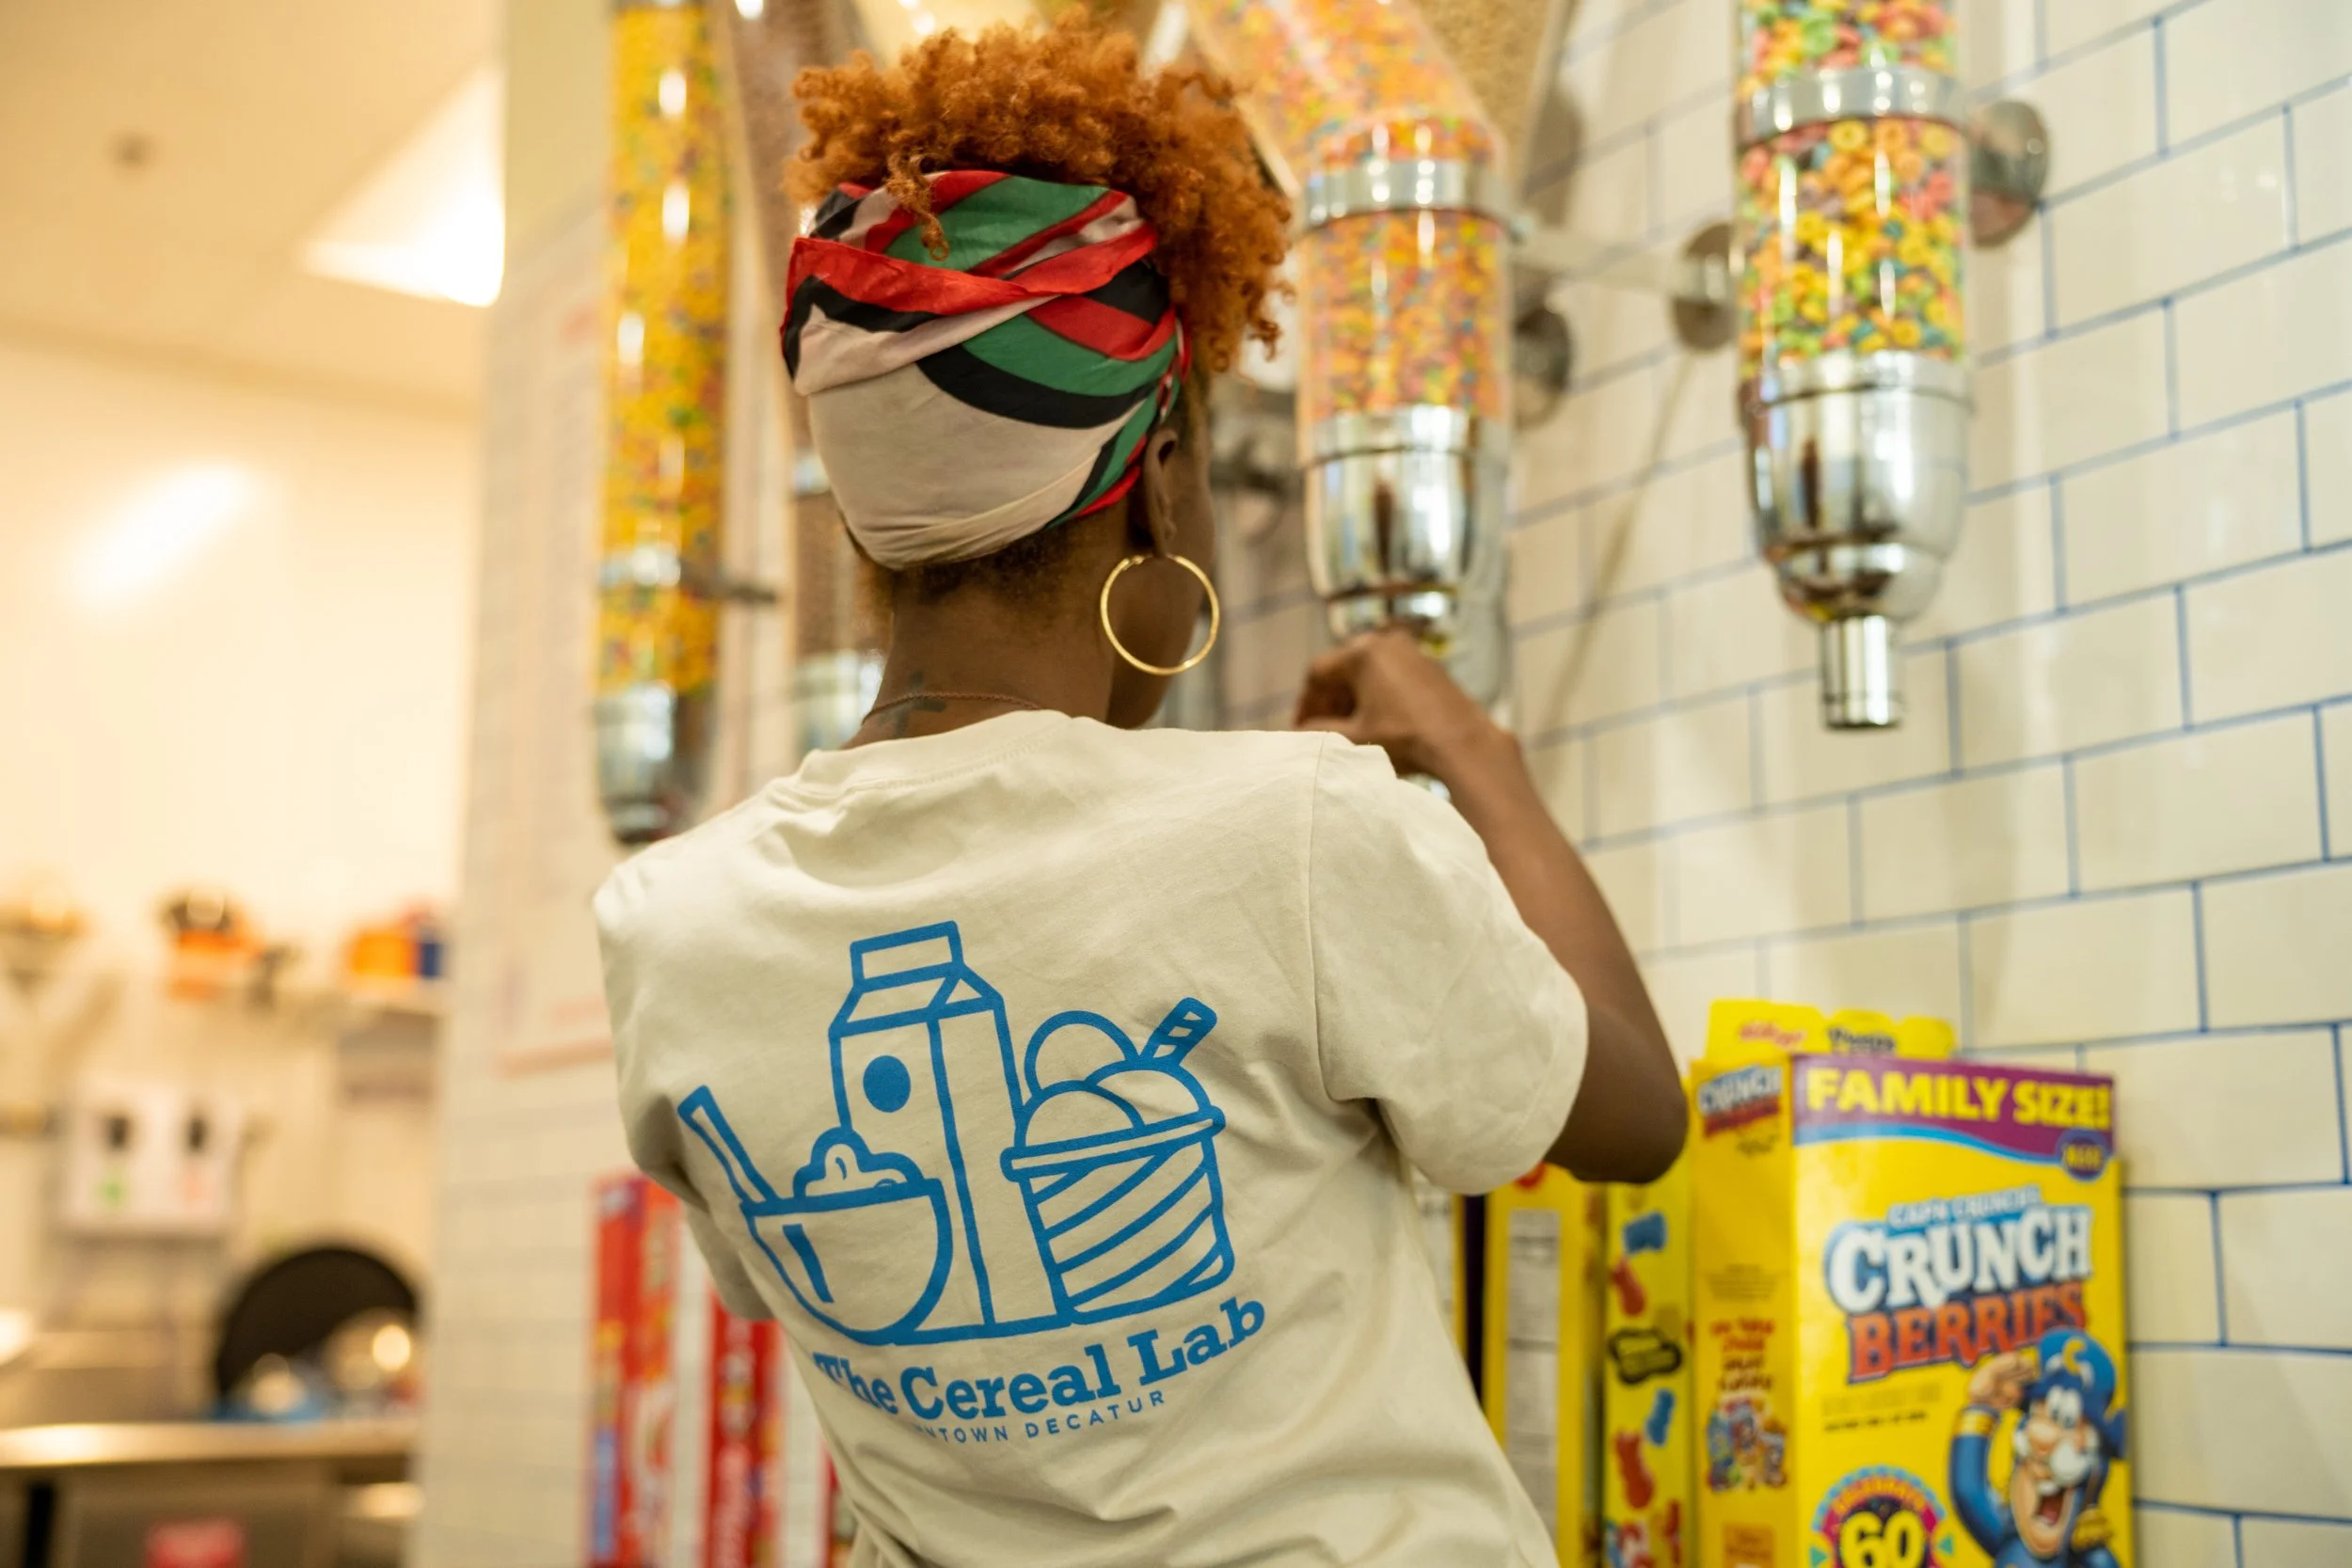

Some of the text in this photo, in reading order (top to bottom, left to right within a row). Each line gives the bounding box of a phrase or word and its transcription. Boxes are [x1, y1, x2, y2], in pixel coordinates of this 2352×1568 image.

[1804, 1068, 2008, 1121] FAMILY
[2013, 1080, 2110, 1131] SIZE!
[1827, 1204, 2091, 1312] CRUNCH
[812, 1296, 1266, 1420] The Cereal Lab
[1845, 1280, 2087, 1385] BERRIES
[1025, 1389, 1166, 1439] DECATUR
[1839, 1510, 1925, 1568] 60
